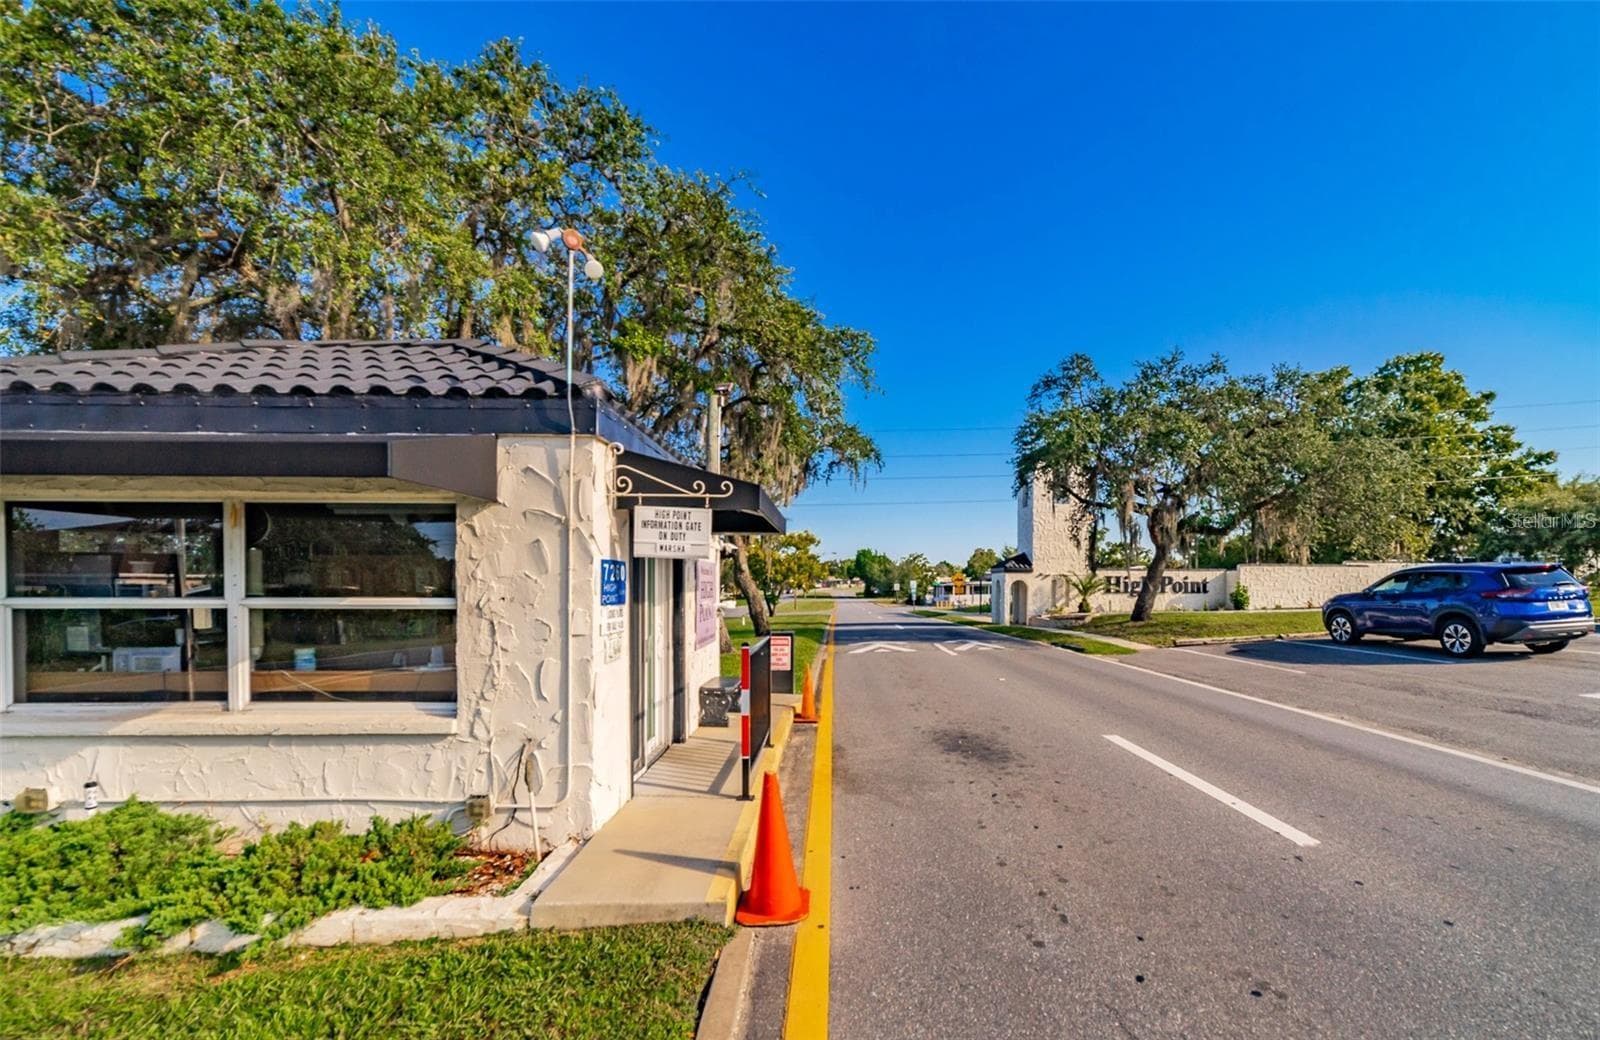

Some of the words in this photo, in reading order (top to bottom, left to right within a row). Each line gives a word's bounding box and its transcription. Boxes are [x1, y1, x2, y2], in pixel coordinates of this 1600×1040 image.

[654, 510, 671, 519] HIGH
[673, 511, 692, 520] POINT
[641, 520, 683, 530] INFORMATION
[685, 522, 702, 532] GATE
[659, 531, 668, 540] ON
[670, 532, 686, 541] DUTY
[1104, 575, 1146, 597] Hig
[1160, 576, 1210, 594] Point
